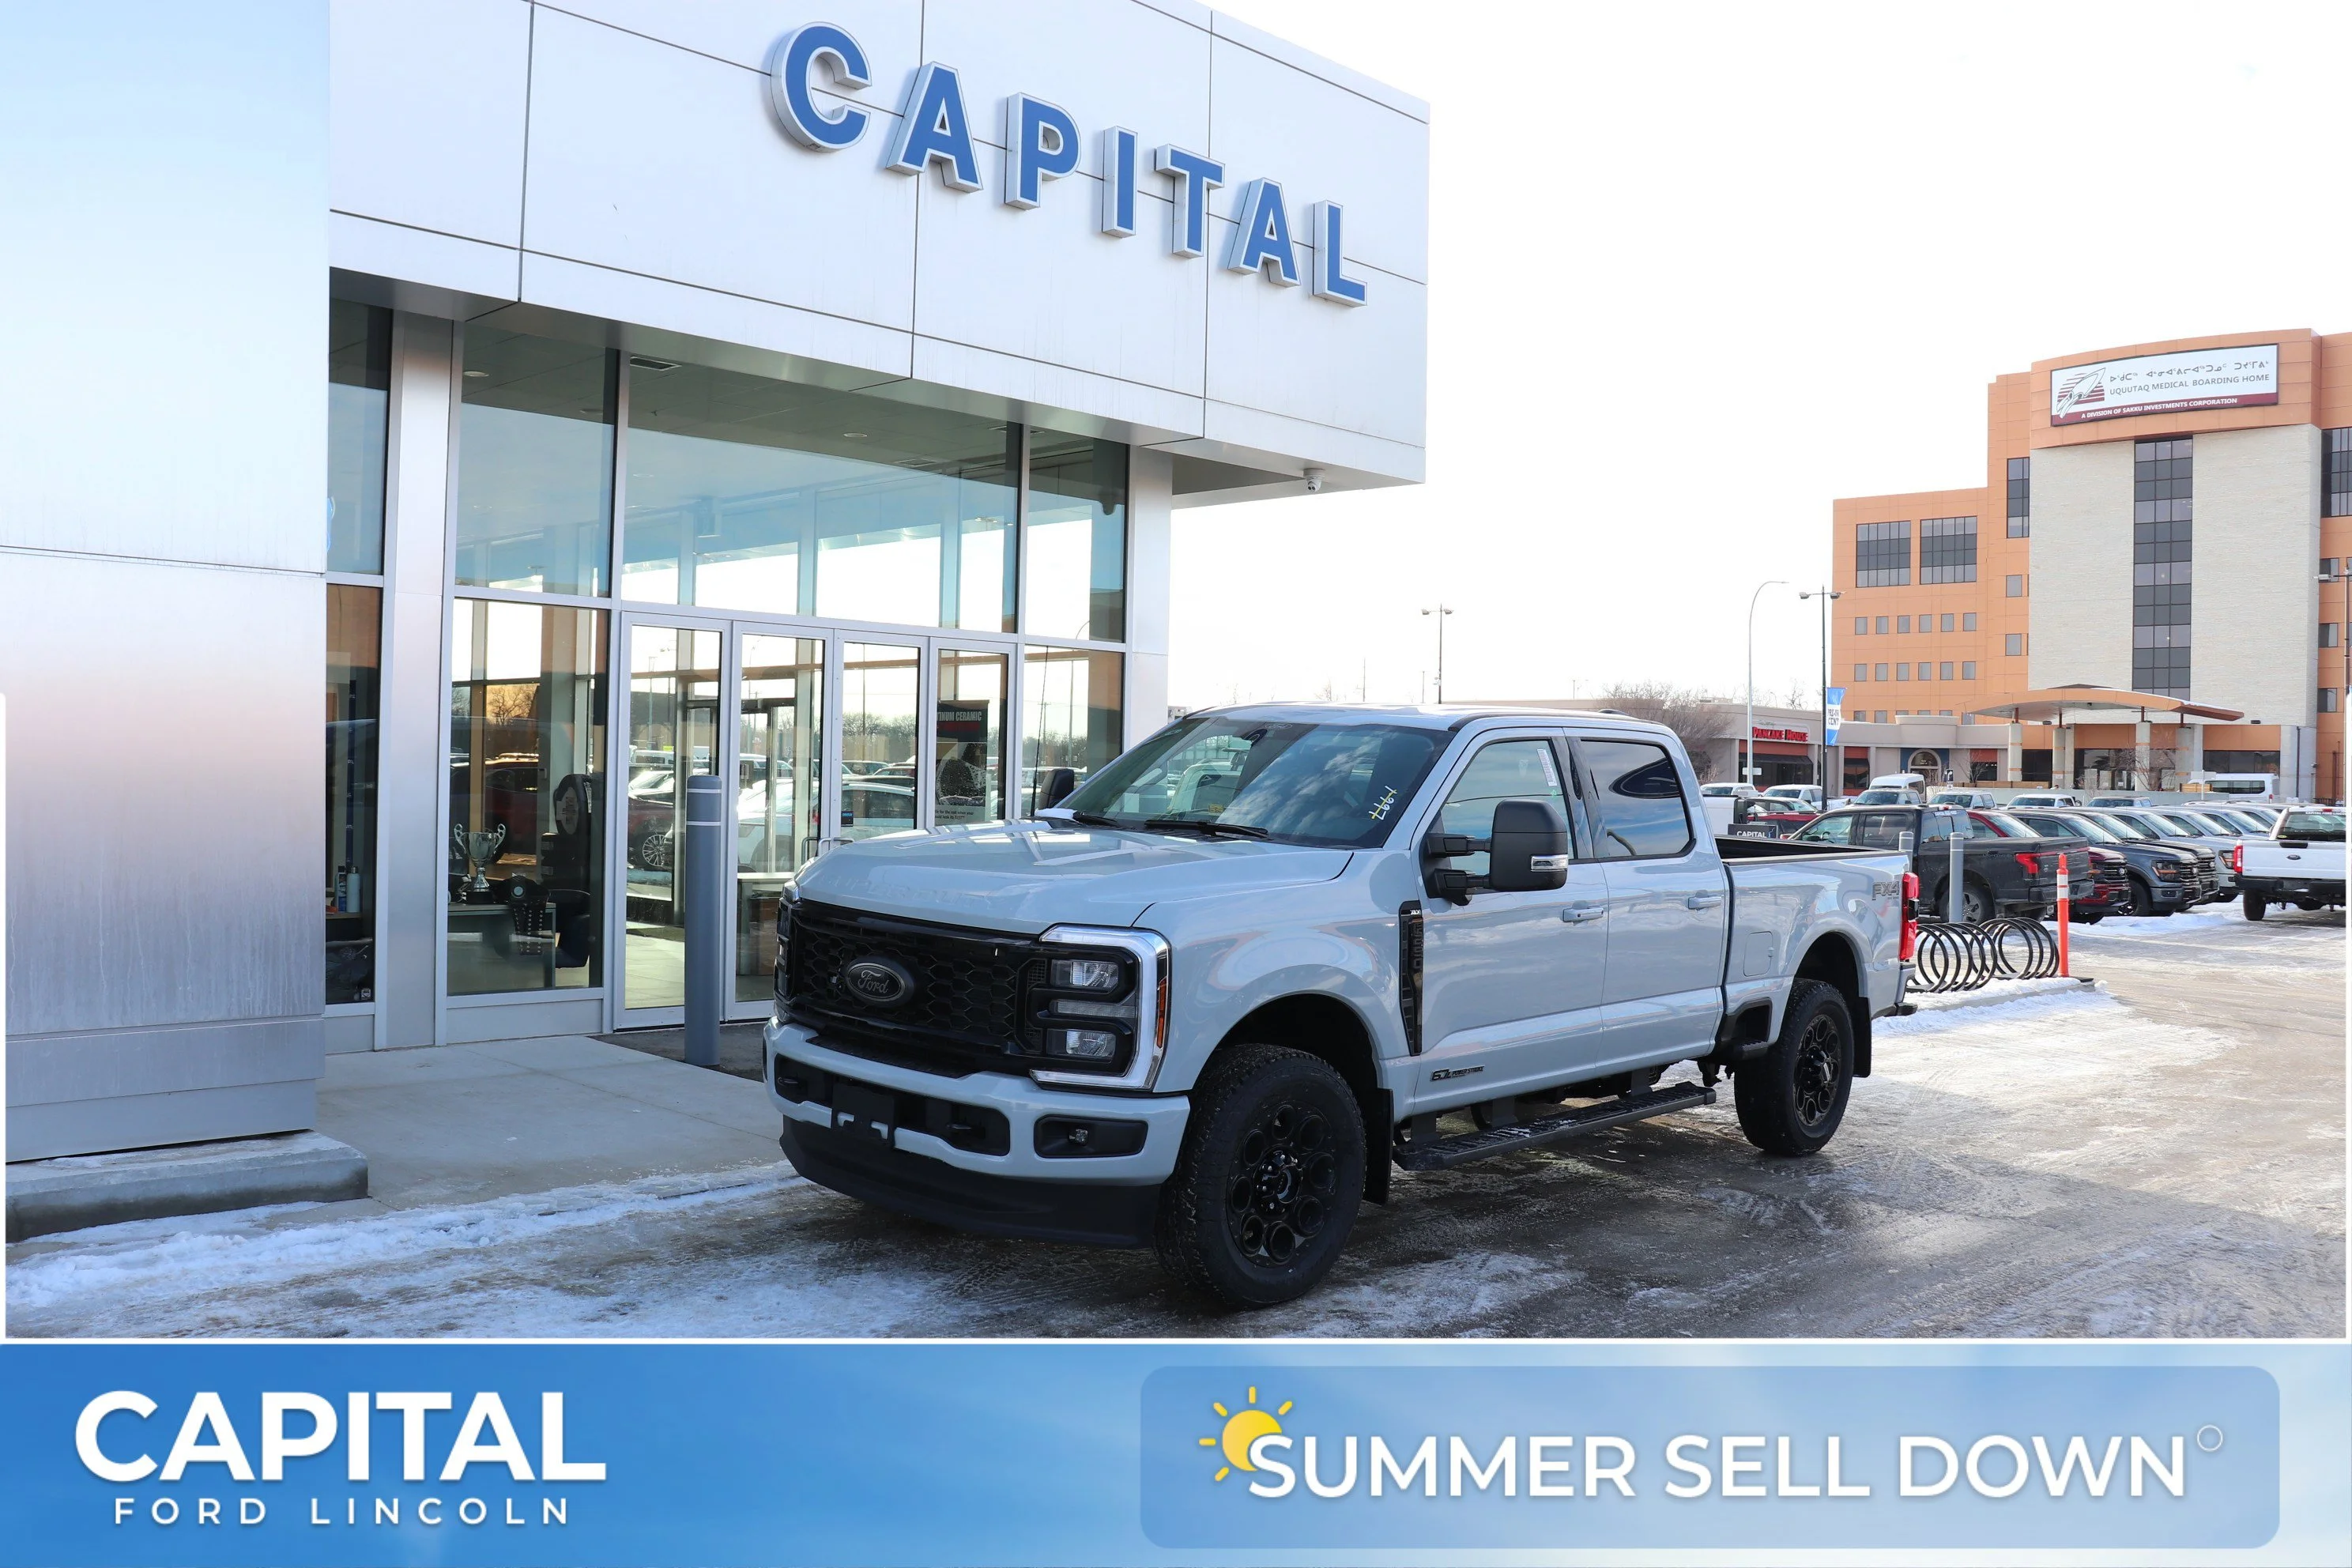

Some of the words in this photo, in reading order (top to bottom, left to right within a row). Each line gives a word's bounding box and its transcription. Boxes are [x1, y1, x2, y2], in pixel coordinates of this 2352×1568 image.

[771, 21, 1367, 308] CAPITAL
[2109, 384, 2150, 395] UQUUTAQ
[2151, 380, 2188, 390] MEDICAL
[2192, 376, 2239, 386] BOARDING
[2242, 374, 2270, 383] HOME
[2086, 409, 2113, 418] DIVISION
[2143, 401, 2188, 411] INVESTMENTS
[2188, 398, 2237, 406] CORPORATION
[956, 710, 982, 722] CERAMIC
[1871, 880, 1900, 900] FX4
[858, 970, 888, 994] Ford
